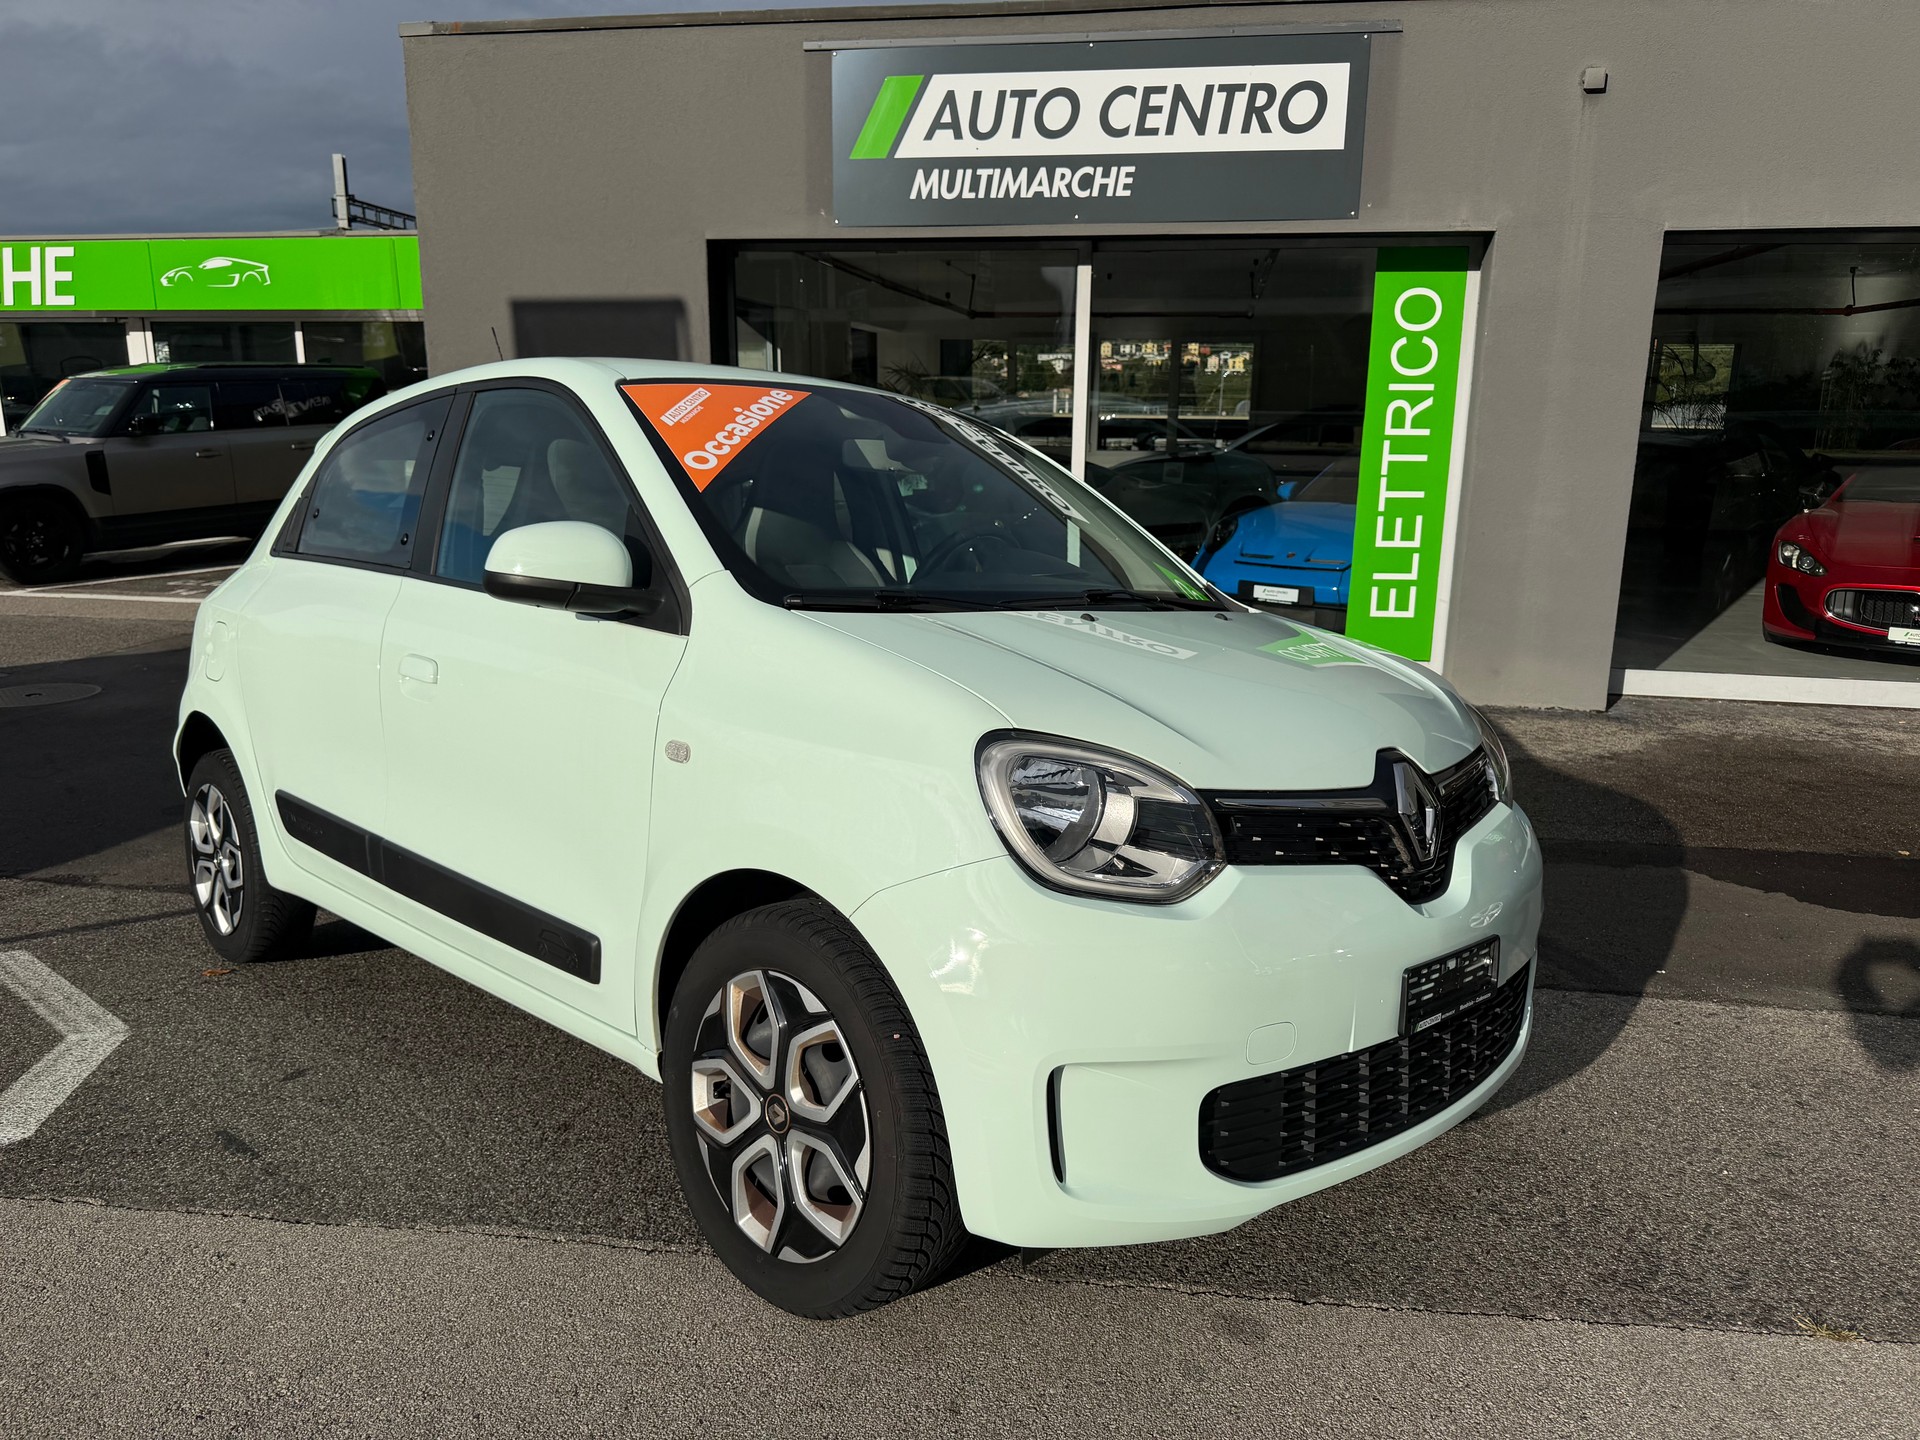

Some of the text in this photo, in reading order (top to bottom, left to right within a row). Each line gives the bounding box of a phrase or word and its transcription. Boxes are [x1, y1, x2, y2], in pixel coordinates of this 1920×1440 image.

[923, 79, 1328, 141] AUTO CENTRO
[909, 165, 1136, 200] MULTIMARCHE
[668, 390, 708, 420] AUTO CENTRO
[683, 389, 794, 470] Occasione
[1369, 287, 1443, 618] ELETTRICO
